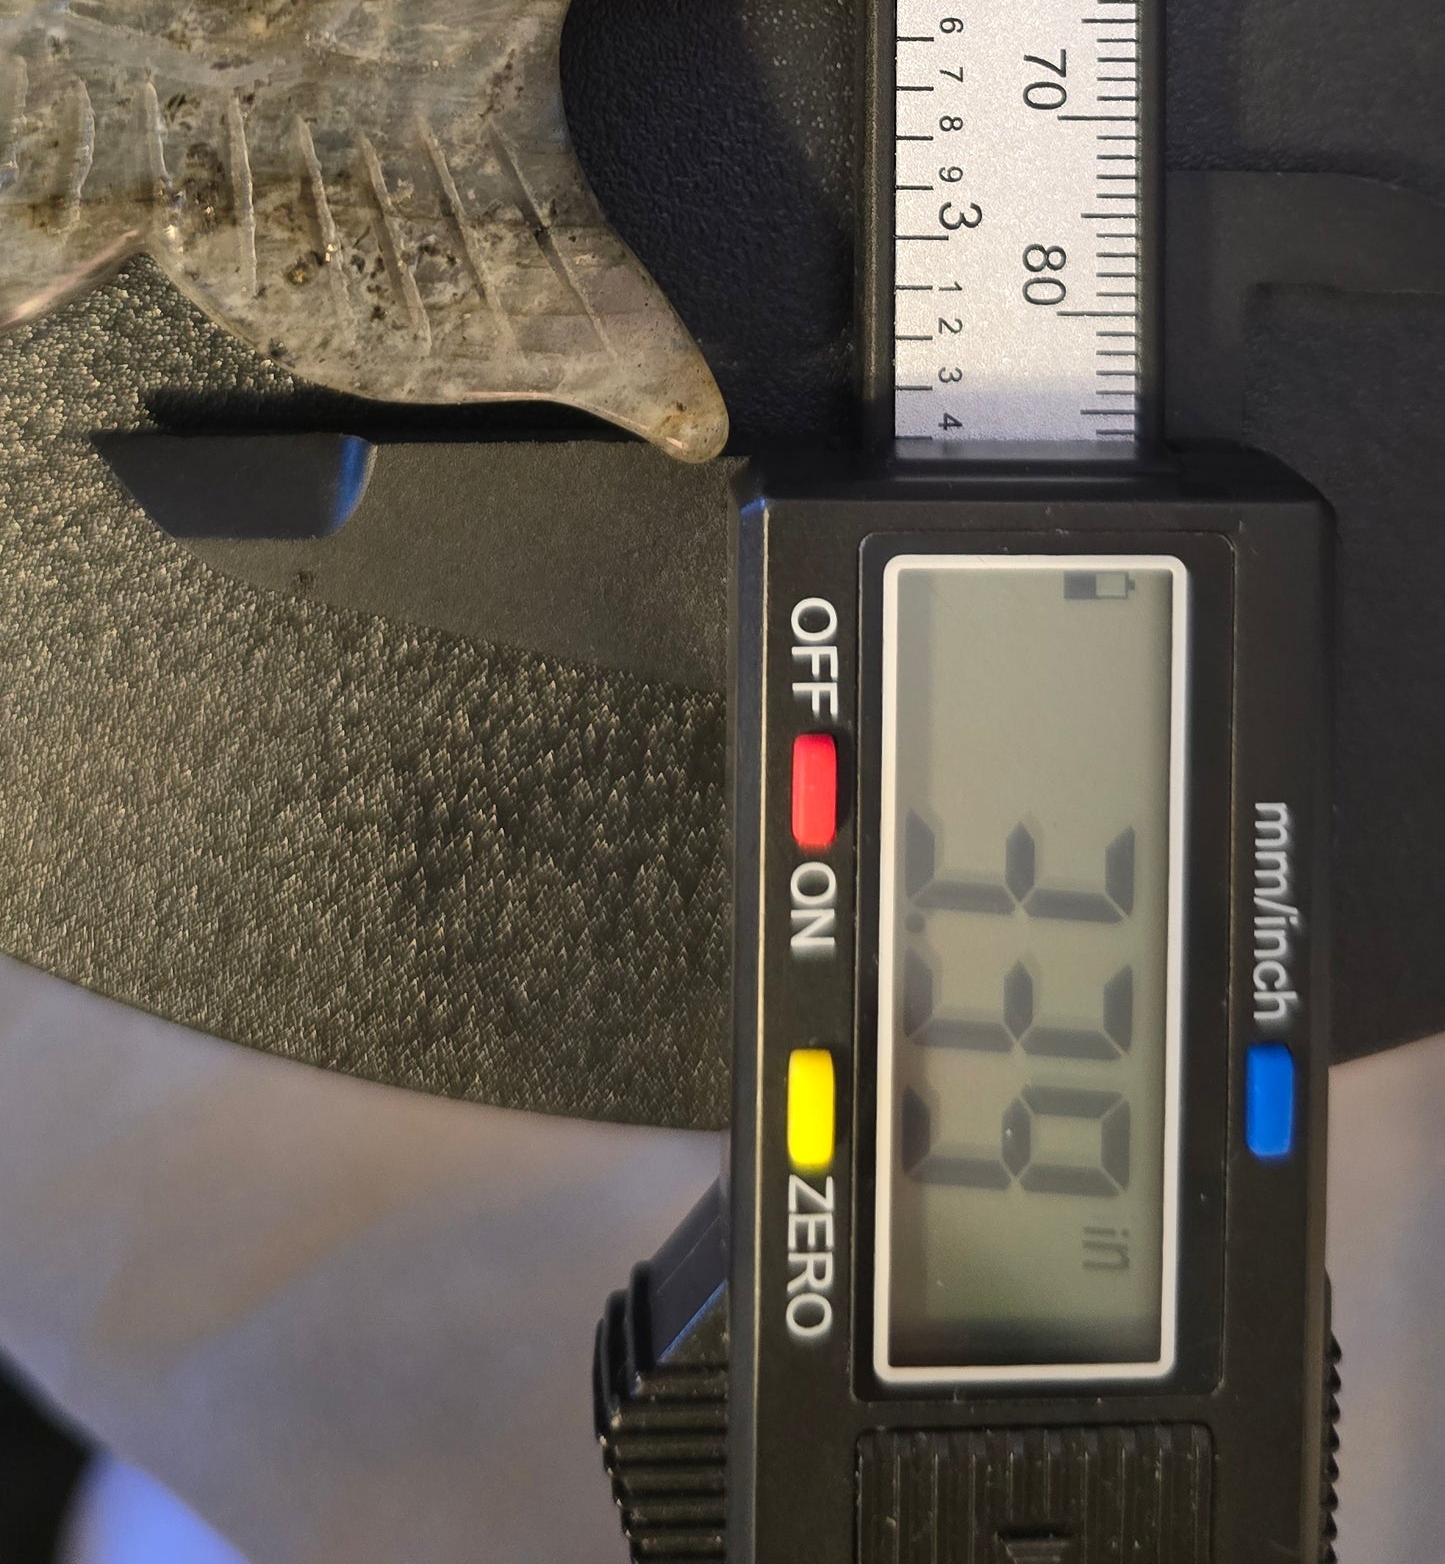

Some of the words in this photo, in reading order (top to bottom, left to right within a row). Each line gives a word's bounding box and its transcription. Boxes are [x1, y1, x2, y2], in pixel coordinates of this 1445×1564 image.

[939, 17, 964, 34] 6
[939, 66, 964, 83] 7
[1022, 48, 1068, 111] 70
[939, 115, 964, 132] 8
[938, 166, 964, 183] 9
[938, 201, 983, 231] 3
[1022, 243, 1067, 306] 80
[938, 317, 963, 335] 2
[938, 367, 963, 384] 3
[938, 412, 963, 431] 4
[790, 596, 838, 719] OFF
[789, 861, 836, 951] ON
[1252, 801, 1298, 1022] mm/inch
[902, 809, 1136, 1198] 3.39
[1081, 1225, 1129, 1272] in
[785, 1175, 834, 1339] ZERO
